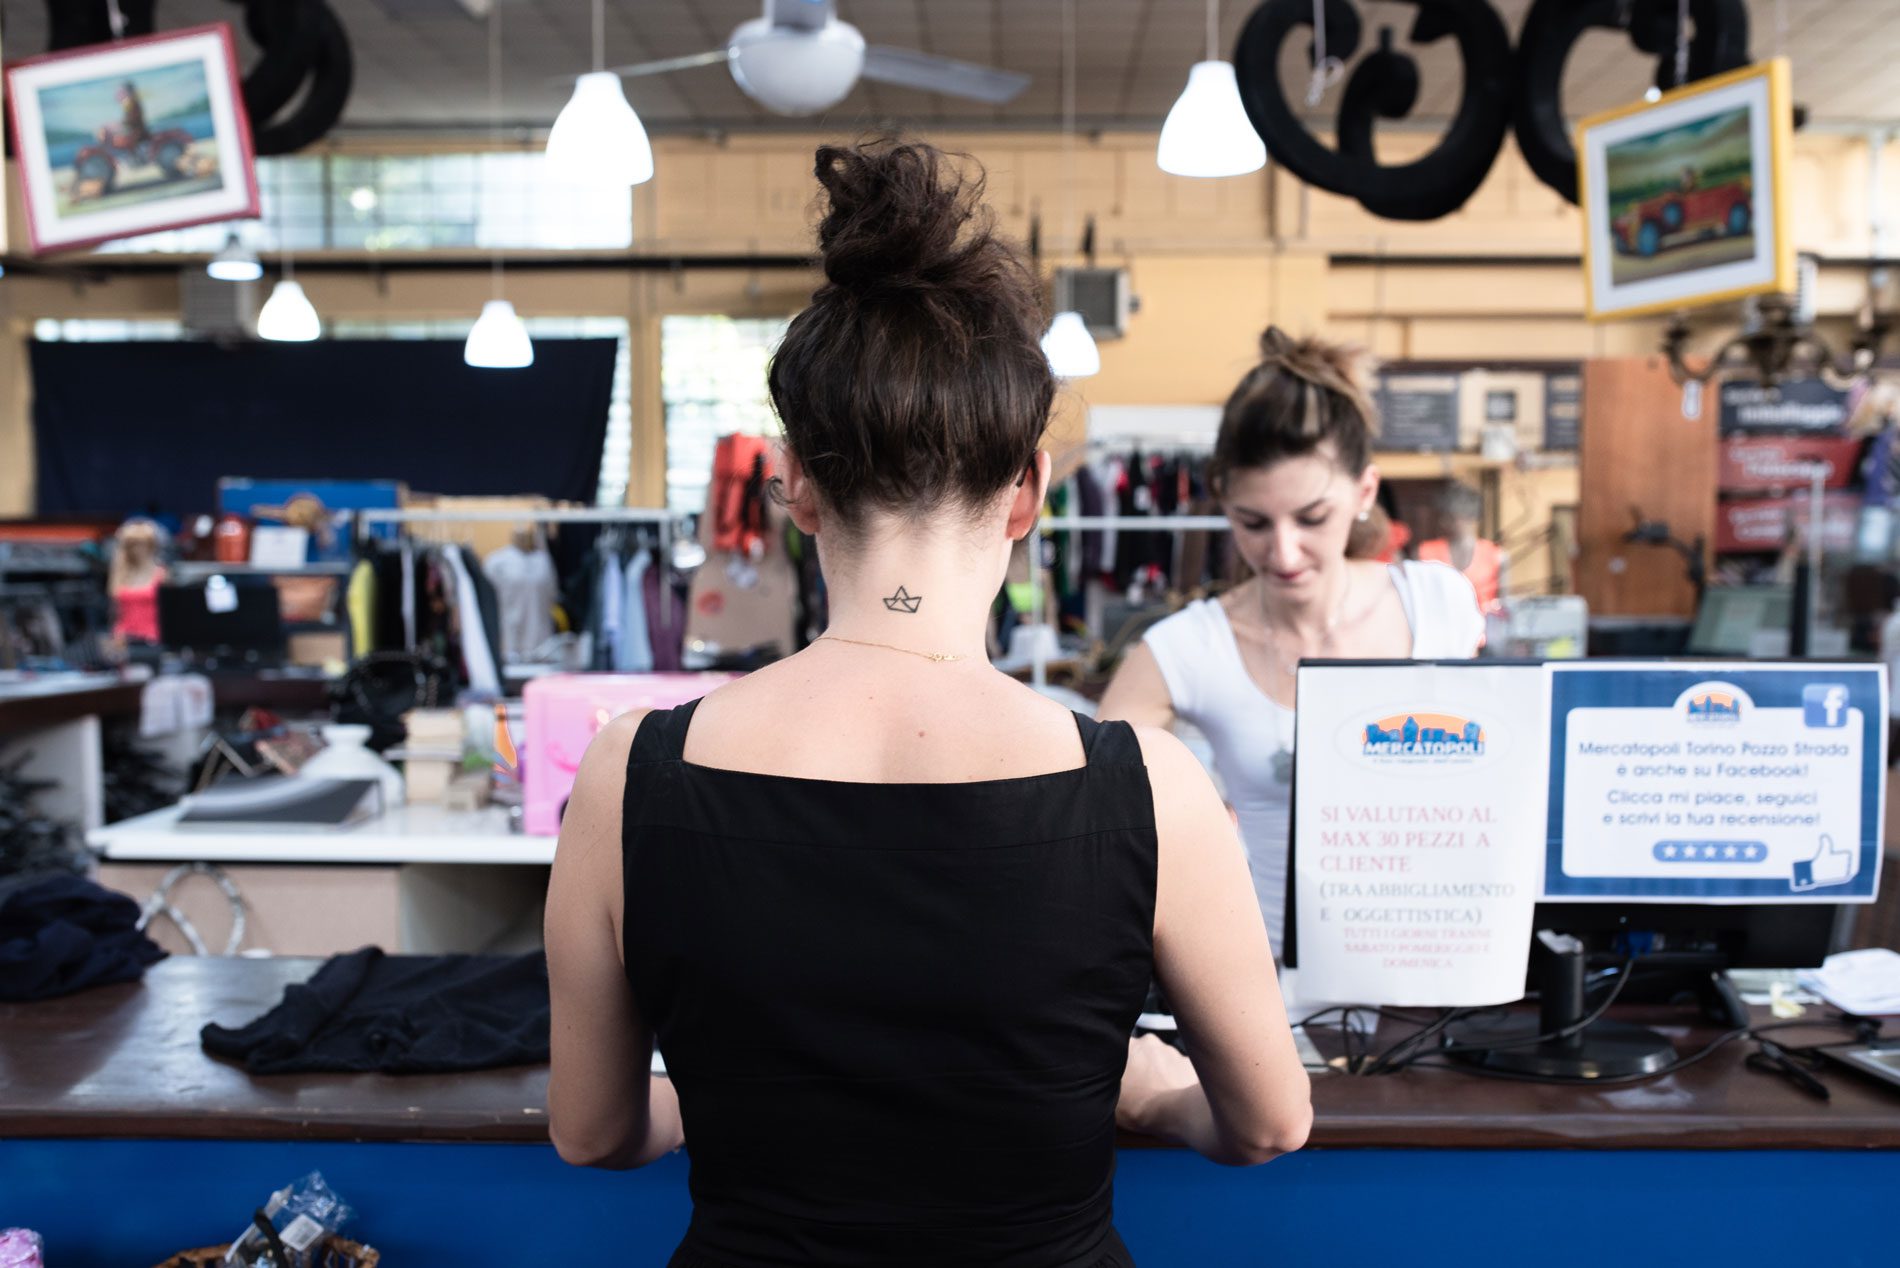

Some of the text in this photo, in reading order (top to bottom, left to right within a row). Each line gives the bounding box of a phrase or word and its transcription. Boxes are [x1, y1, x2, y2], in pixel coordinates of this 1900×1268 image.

[1363, 741, 1485, 755] MERCATOPOLI
[1578, 742, 1850, 757] Mercatopoli Torino Pozzo Strada
[1616, 763, 1809, 777] è anche su Facebook!
[1607, 789, 1817, 808] Clicca mi piace, seguici
[1321, 806, 1498, 823] SI VALUTANO AL
[1603, 812, 1821, 826] e scrivi la tua recensione!
[1320, 831, 1491, 848] MAX 30 PEZZI A
[1320, 855, 1412, 873] CLIENTE
[1366, 883, 1515, 898] ABBIGLIAMENTO
[1320, 906, 1482, 924] E OGGETTISTICA)
[1343, 927, 1381, 940] TUTTI
[1344, 943, 1395, 954] SABATO
